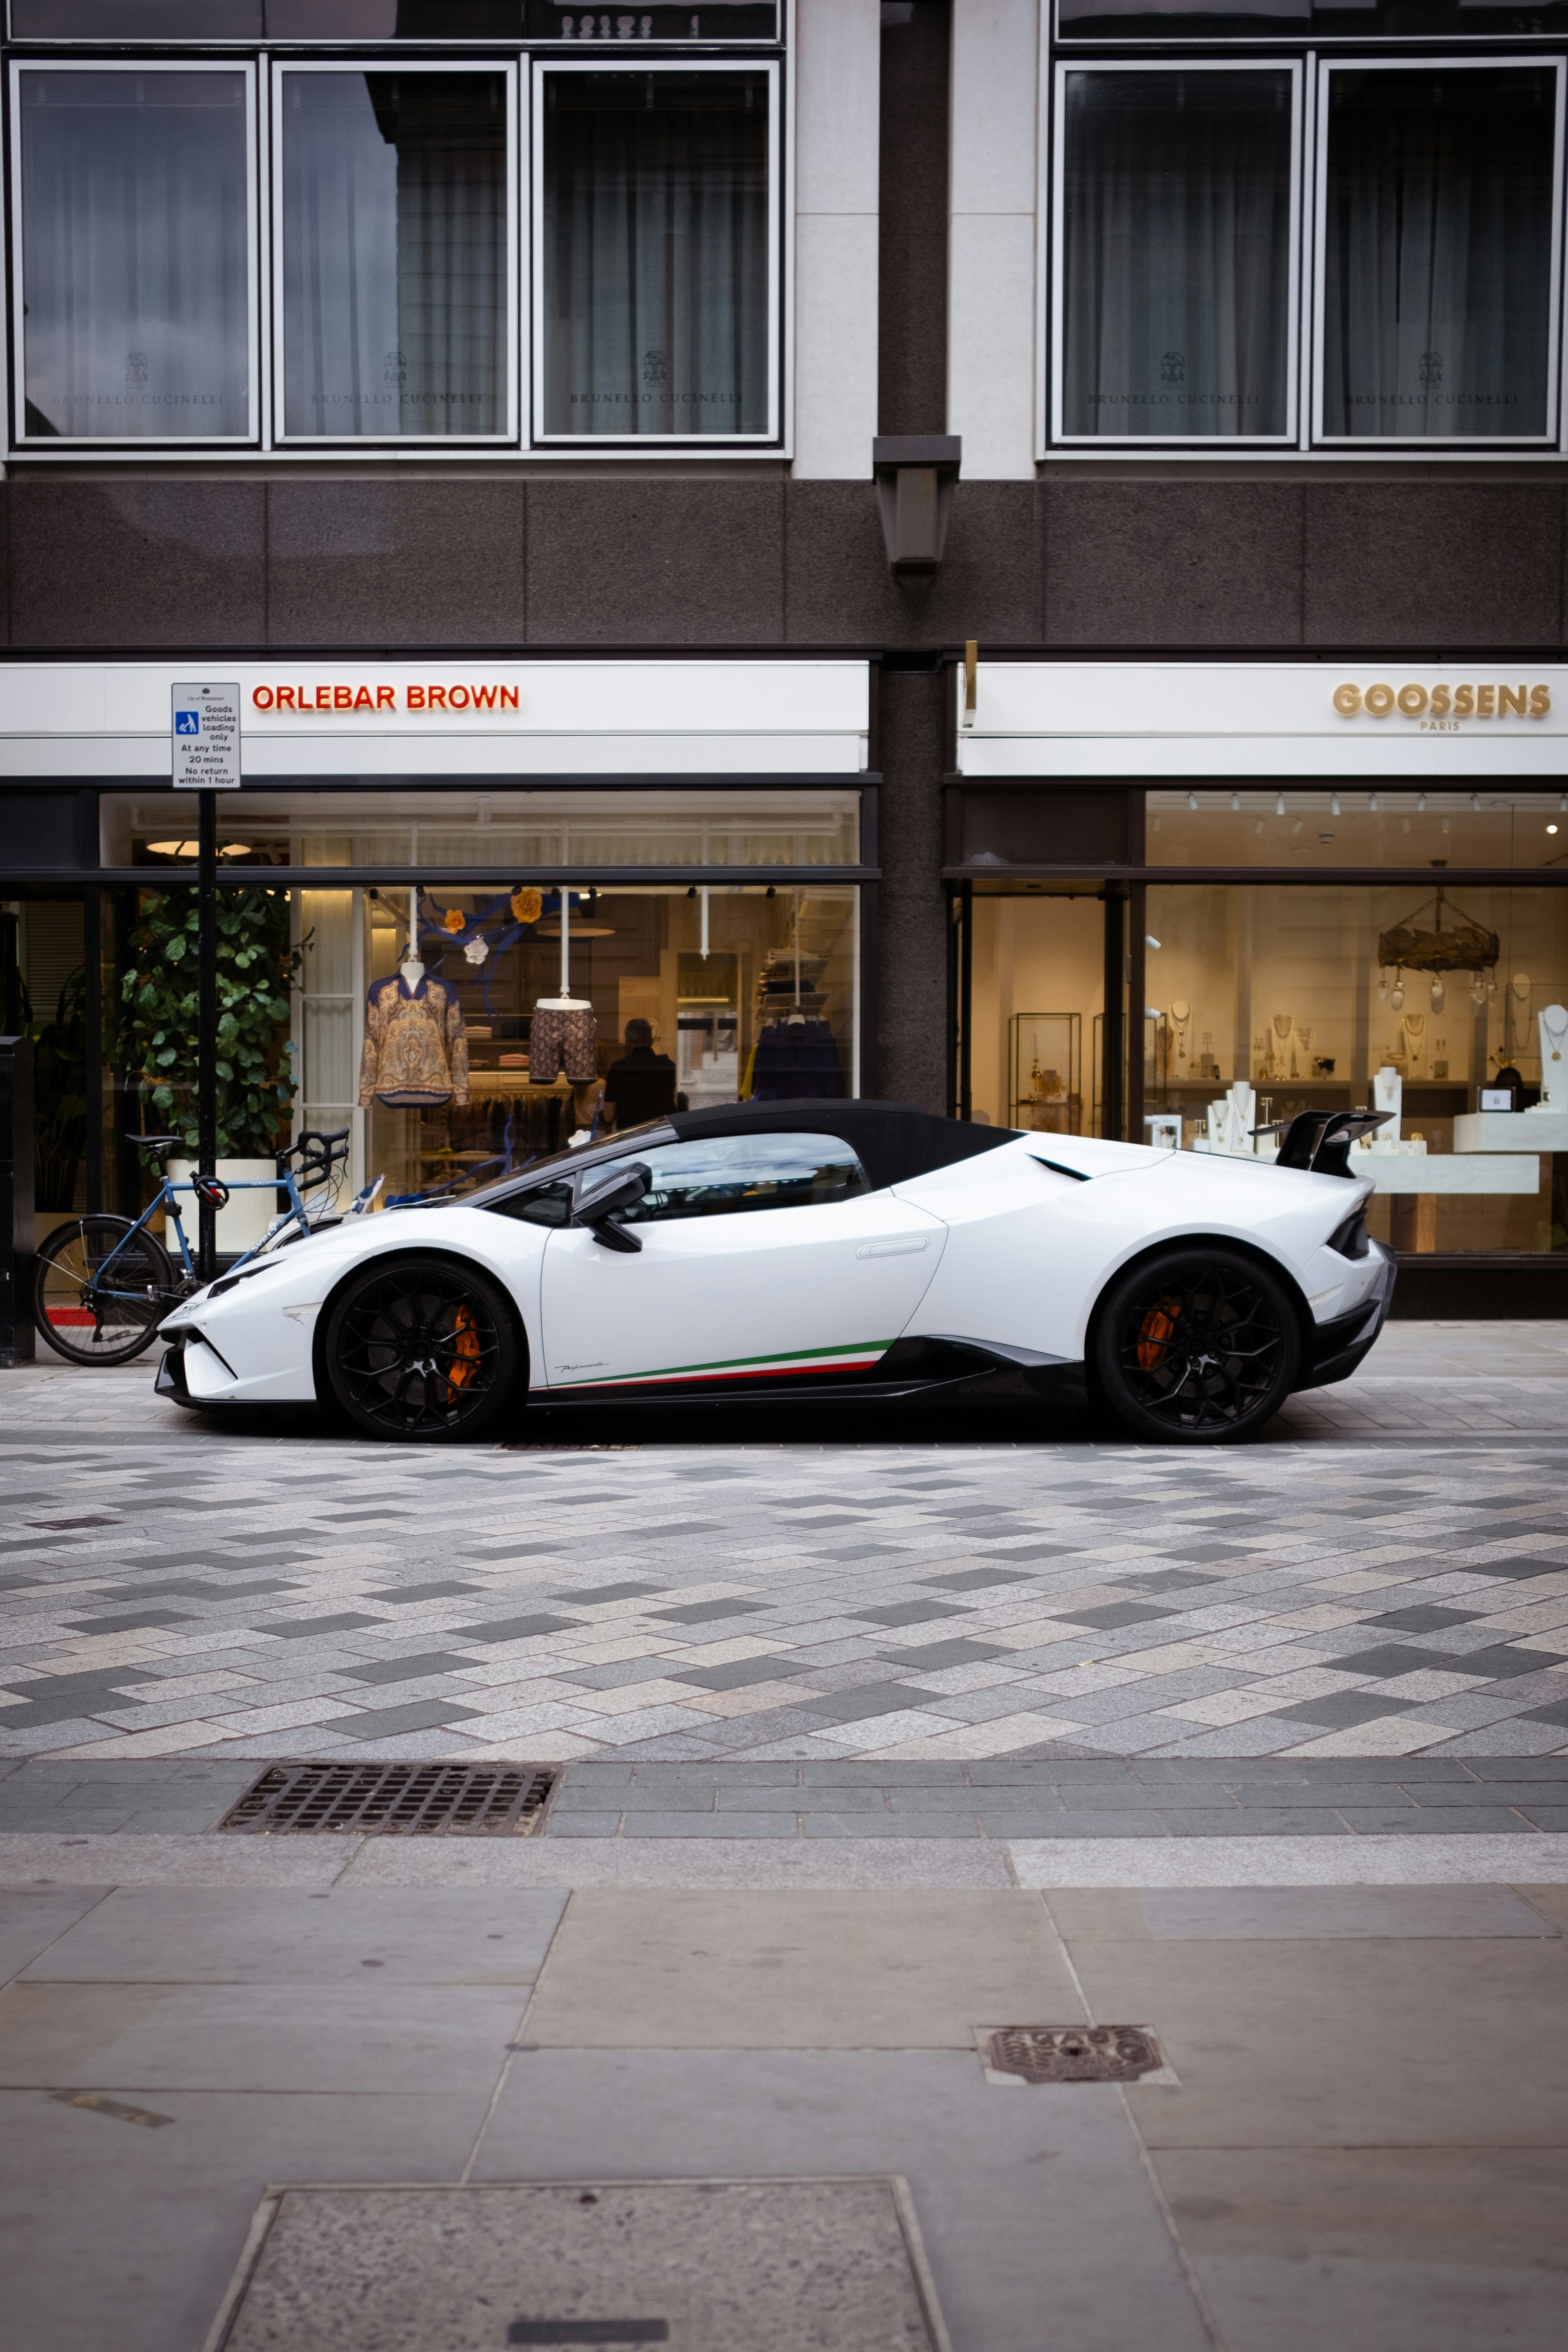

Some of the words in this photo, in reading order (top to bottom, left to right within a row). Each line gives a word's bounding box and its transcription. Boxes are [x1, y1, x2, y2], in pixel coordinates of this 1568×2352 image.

[54, 395, 134, 404] BRUNELLO
[141, 395, 223, 404] CUCINELLI
[311, 394, 392, 404] BRUNELLO
[402, 394, 482, 403] CUCINELLI
[571, 393, 652, 403] BRUNELLO
[659, 393, 741, 402] CUCINELLI
[1088, 395, 1170, 404] BRUNELLO
[1177, 395, 1260, 404] CUCINELLI
[252, 685, 396, 709] ORLEBAR
[407, 685, 519, 709] BROWN
[1333, 684, 1551, 715] GOOSSENS
[201, 714, 237, 722] vehicles
[203, 724, 235, 732] loading
[1421, 721, 1460, 731] PARIS
[210, 733, 229, 741] only
